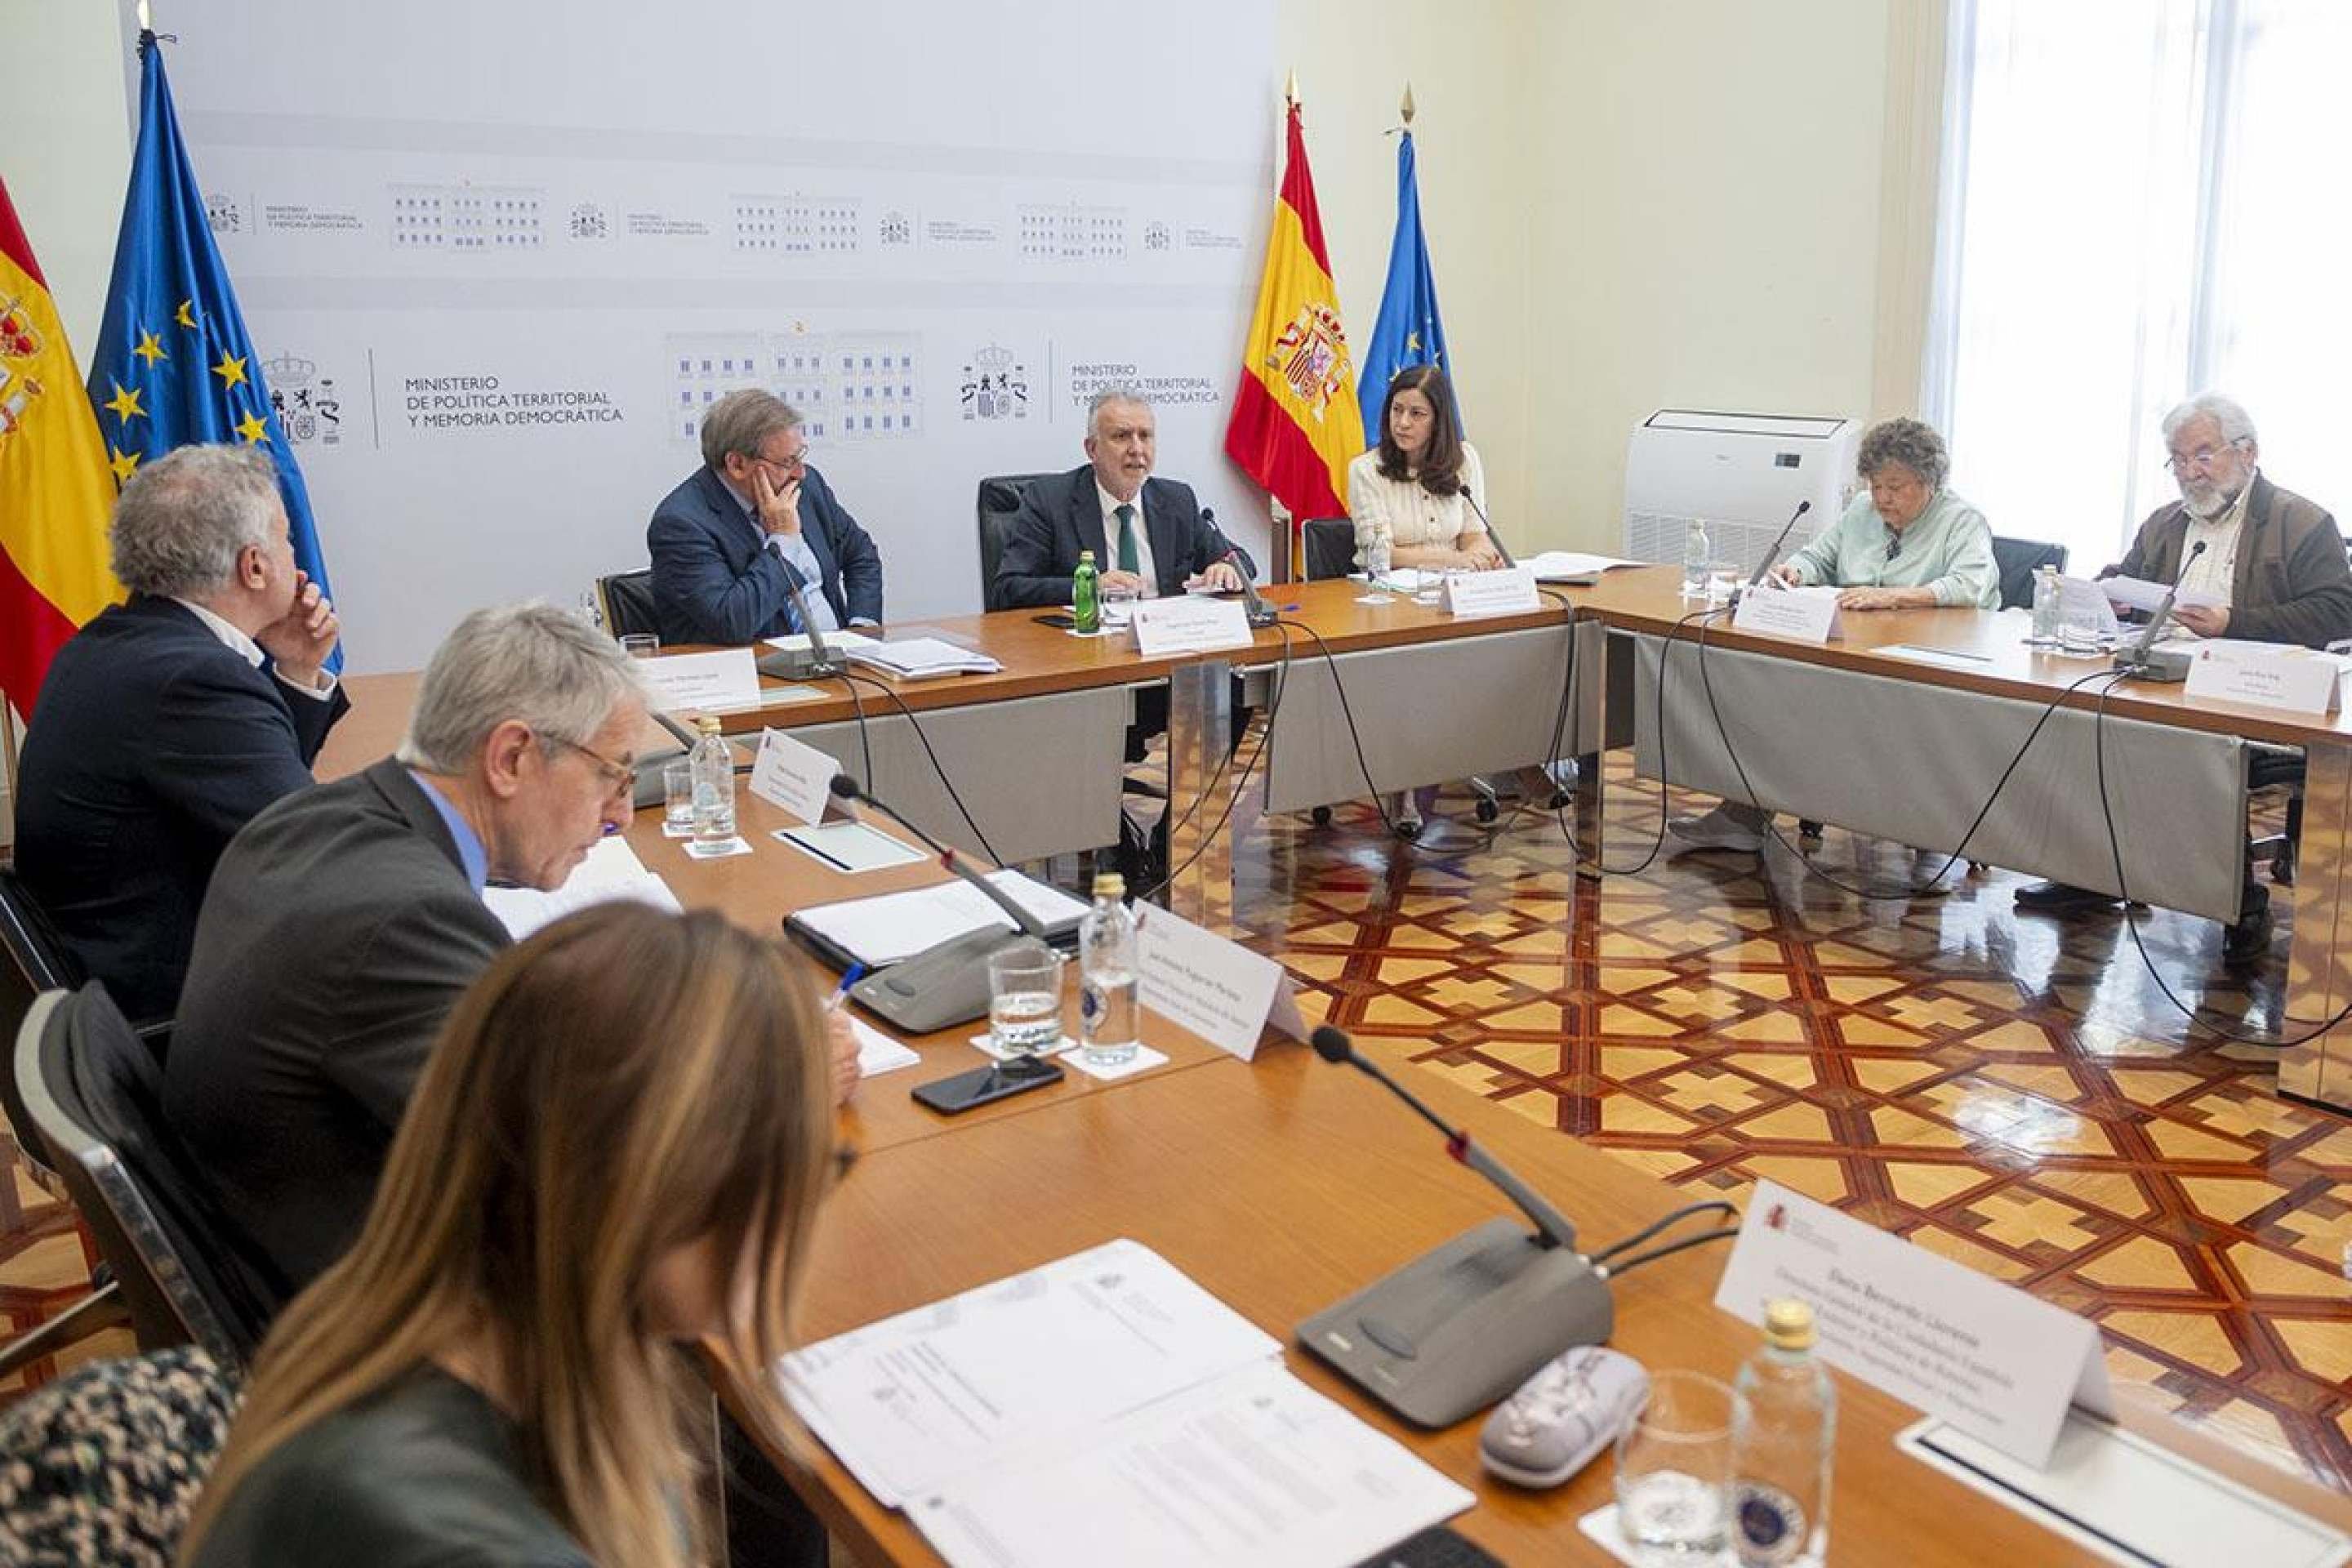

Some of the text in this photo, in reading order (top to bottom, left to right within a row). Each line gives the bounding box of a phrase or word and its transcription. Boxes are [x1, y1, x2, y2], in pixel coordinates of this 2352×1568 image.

[1071, 364, 1138, 376] MINISTERIO
[405, 376, 499, 391] MINISTERIO
[1071, 380, 1088, 392] DE
[407, 391, 612, 410] DE POLÍTICA TERRITORIAL
[408, 413, 418, 428] Y
[424, 411, 501, 428] MEMORIA
